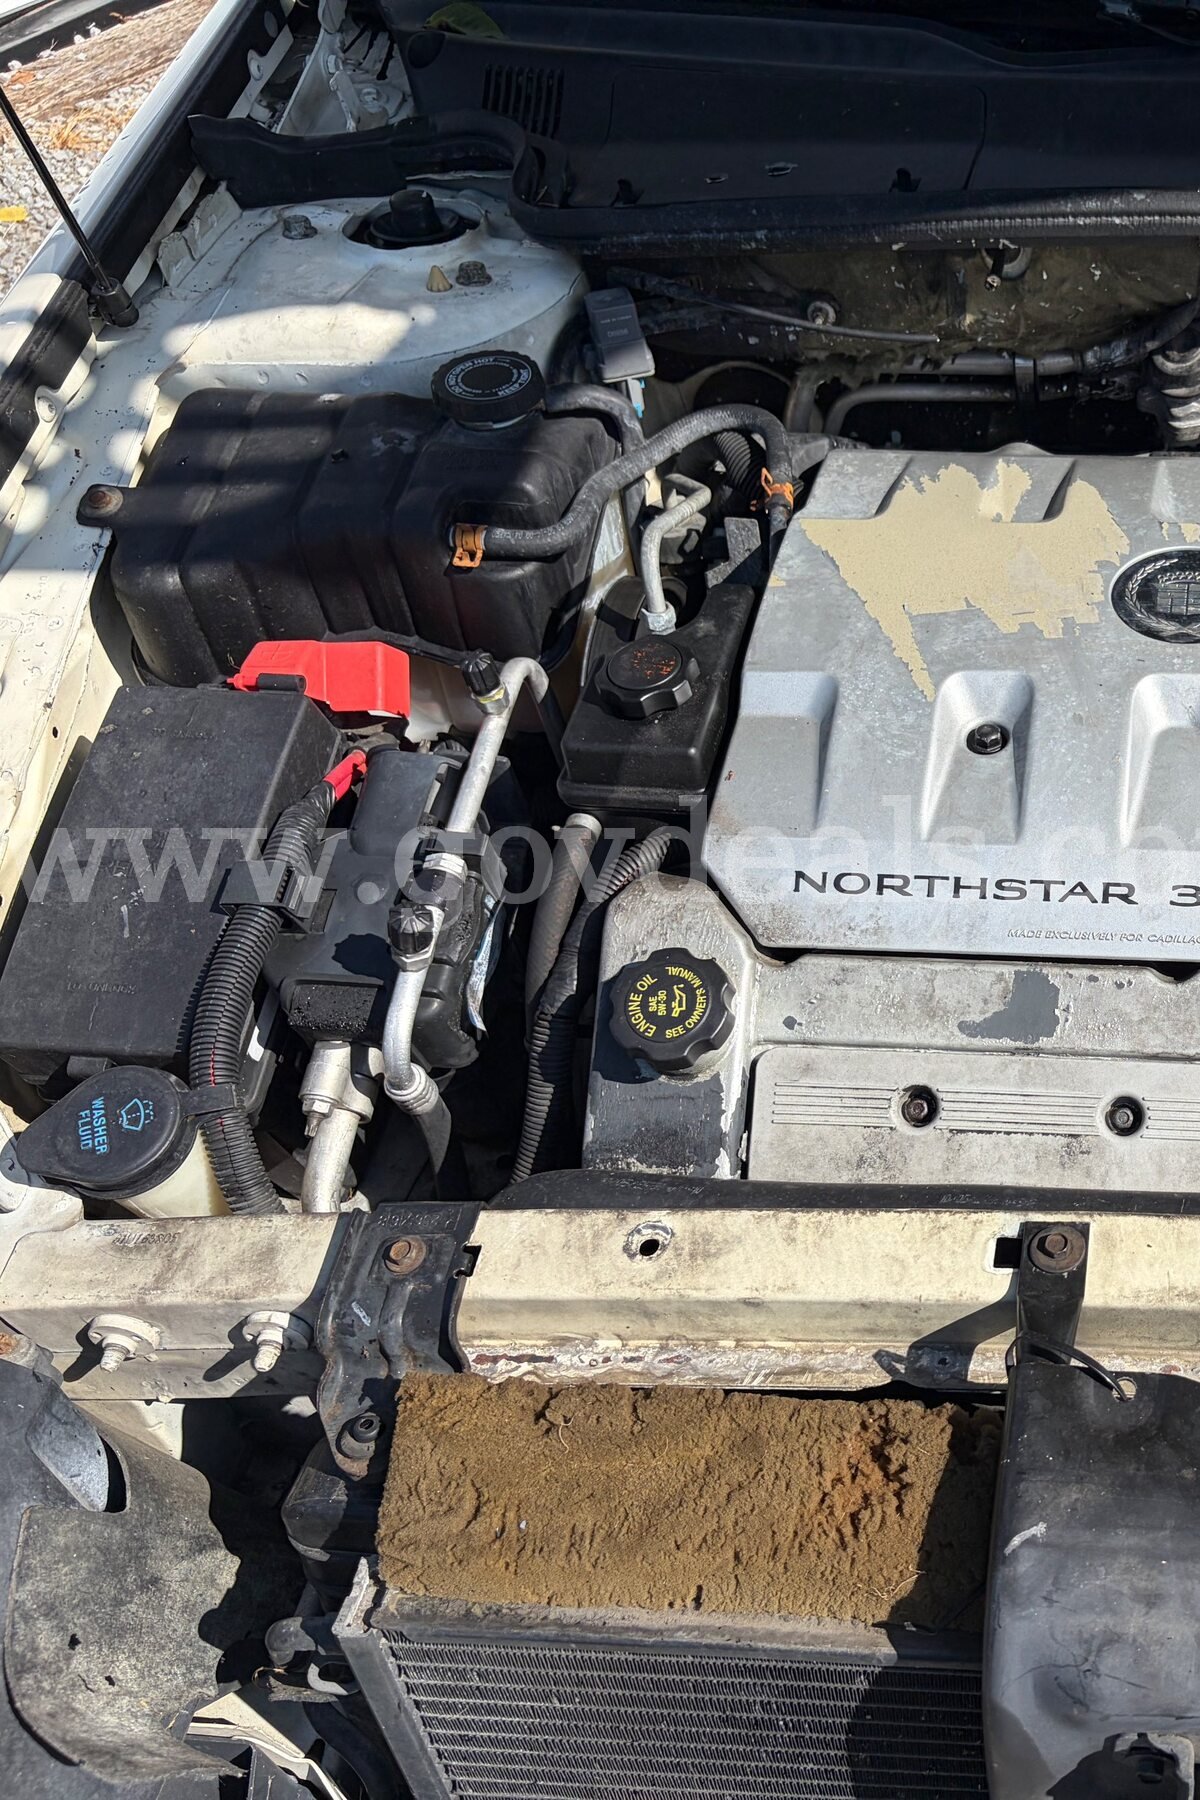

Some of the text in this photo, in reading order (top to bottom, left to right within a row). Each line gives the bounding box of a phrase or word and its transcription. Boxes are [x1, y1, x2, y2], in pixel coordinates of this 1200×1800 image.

[793, 869, 1139, 905] NORTHSTAR
[1007, 929, 1043, 939] MADE
[1045, 930, 1118, 941] EXCLUSIVELY
[1119, 933, 1144, 942] FOR
[664, 966, 703, 988] MANUAL
[628, 974, 658, 1037] ENGINE OIL
[648, 995, 658, 1012] SAE
[657, 990, 667, 1016] 5W-30
[665, 1024, 686, 1039] SEE
[77, 1110, 93, 1150] FLUID
[91, 1096, 108, 1155] WASHER
